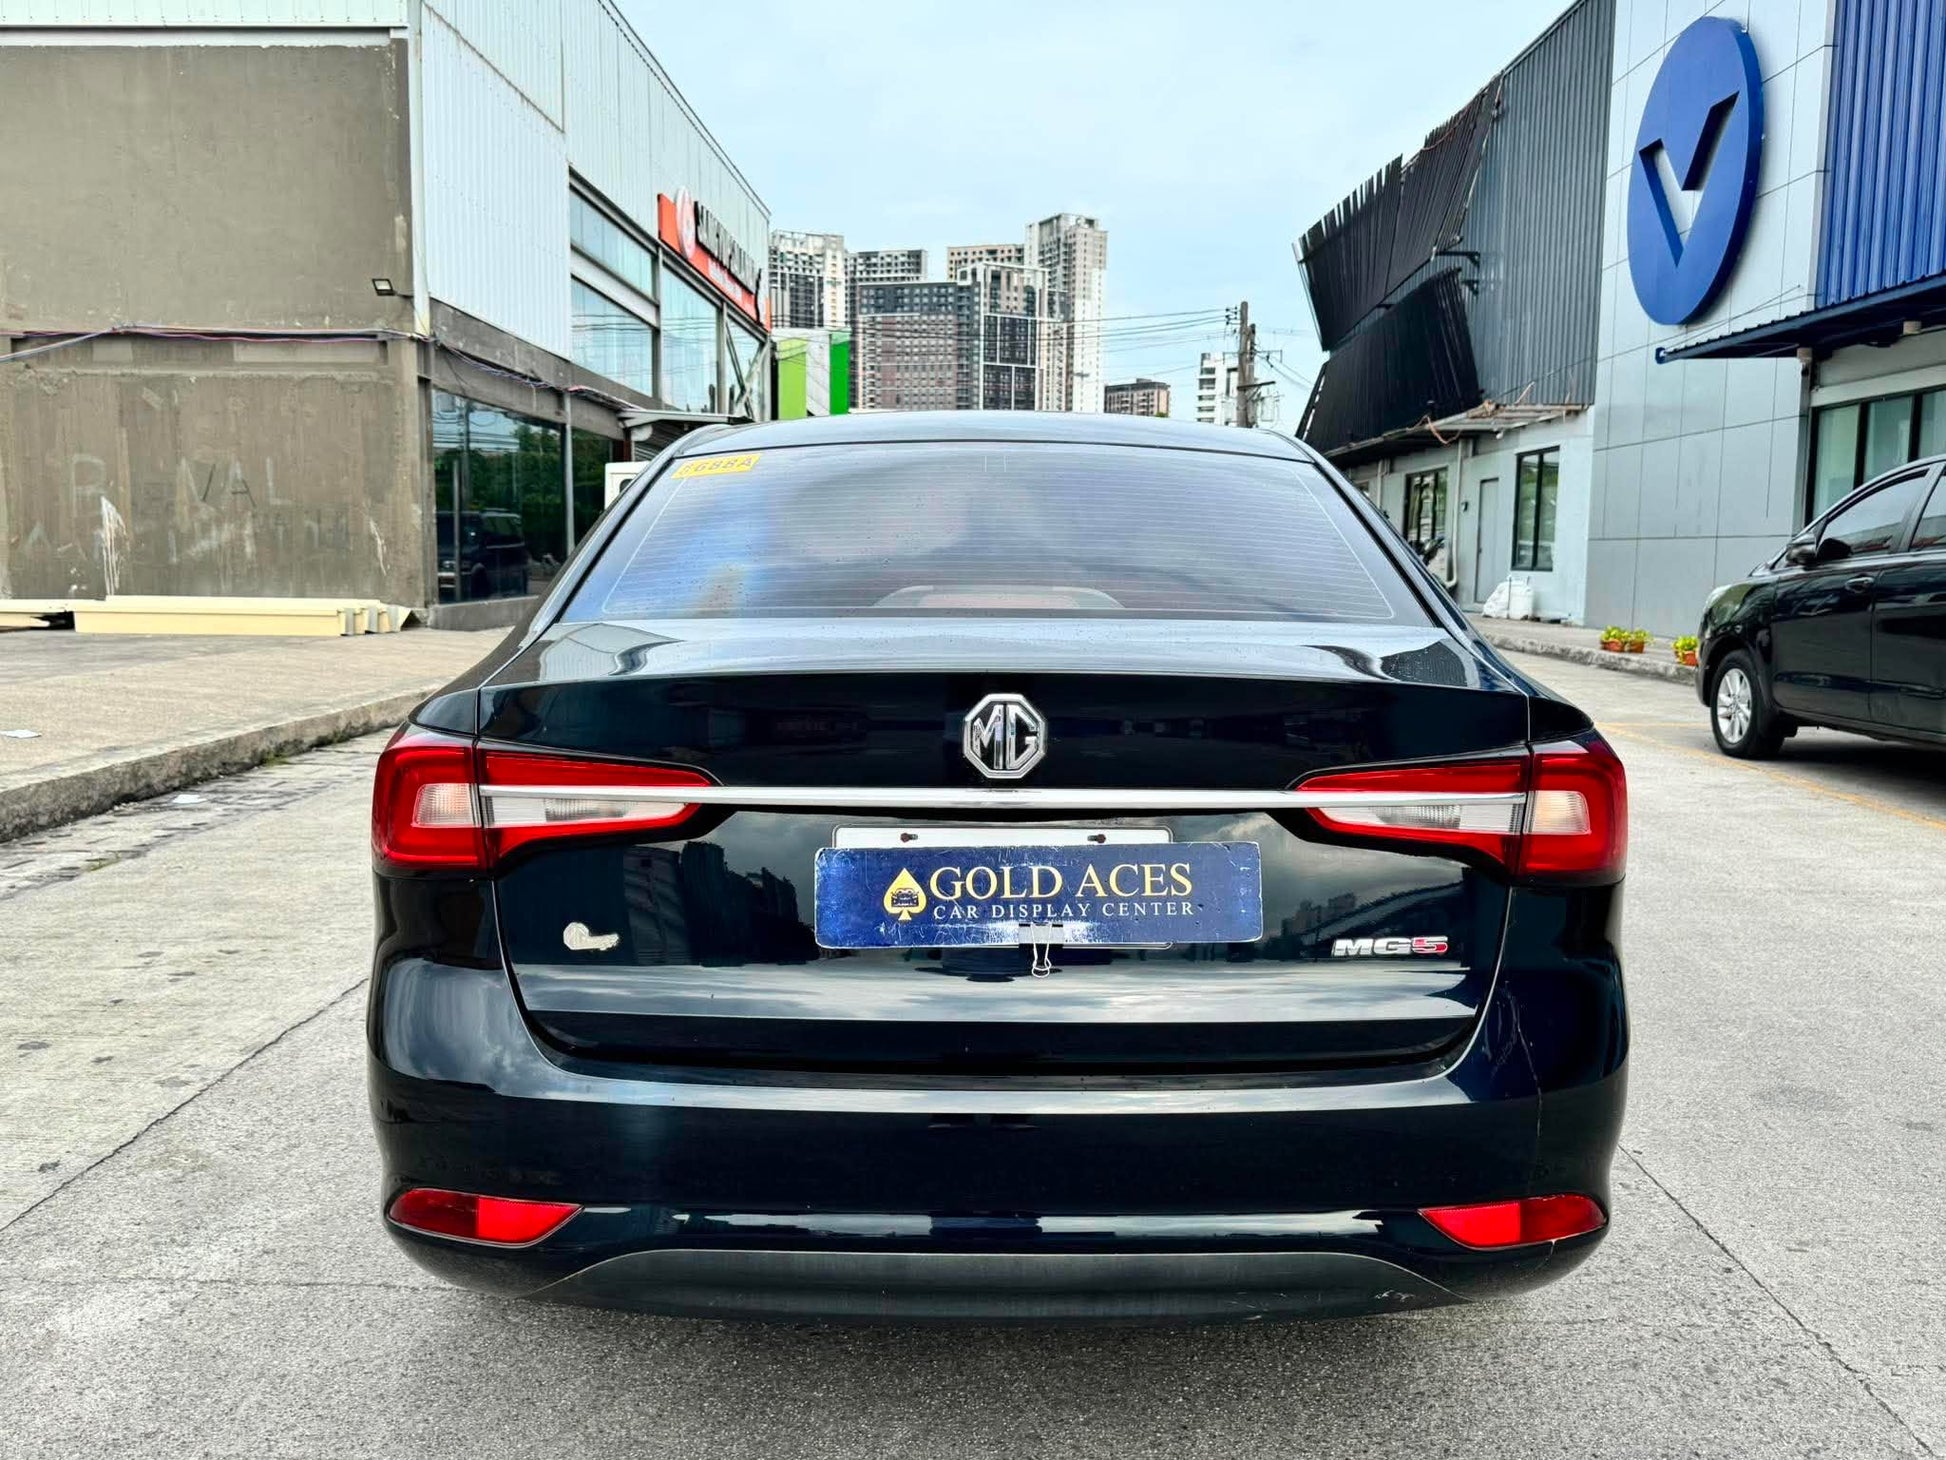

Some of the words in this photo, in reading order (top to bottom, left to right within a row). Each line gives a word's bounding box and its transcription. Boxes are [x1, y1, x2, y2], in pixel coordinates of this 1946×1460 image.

[971, 703, 1038, 770] MG
[929, 864, 1063, 900] GOLD
[1077, 862, 1193, 899] ACES
[933, 904, 979, 920] CAR
[991, 902, 1091, 918] DISPLAY
[1102, 901, 1195, 917] CENTER
[1332, 935, 1449, 957] MG5
